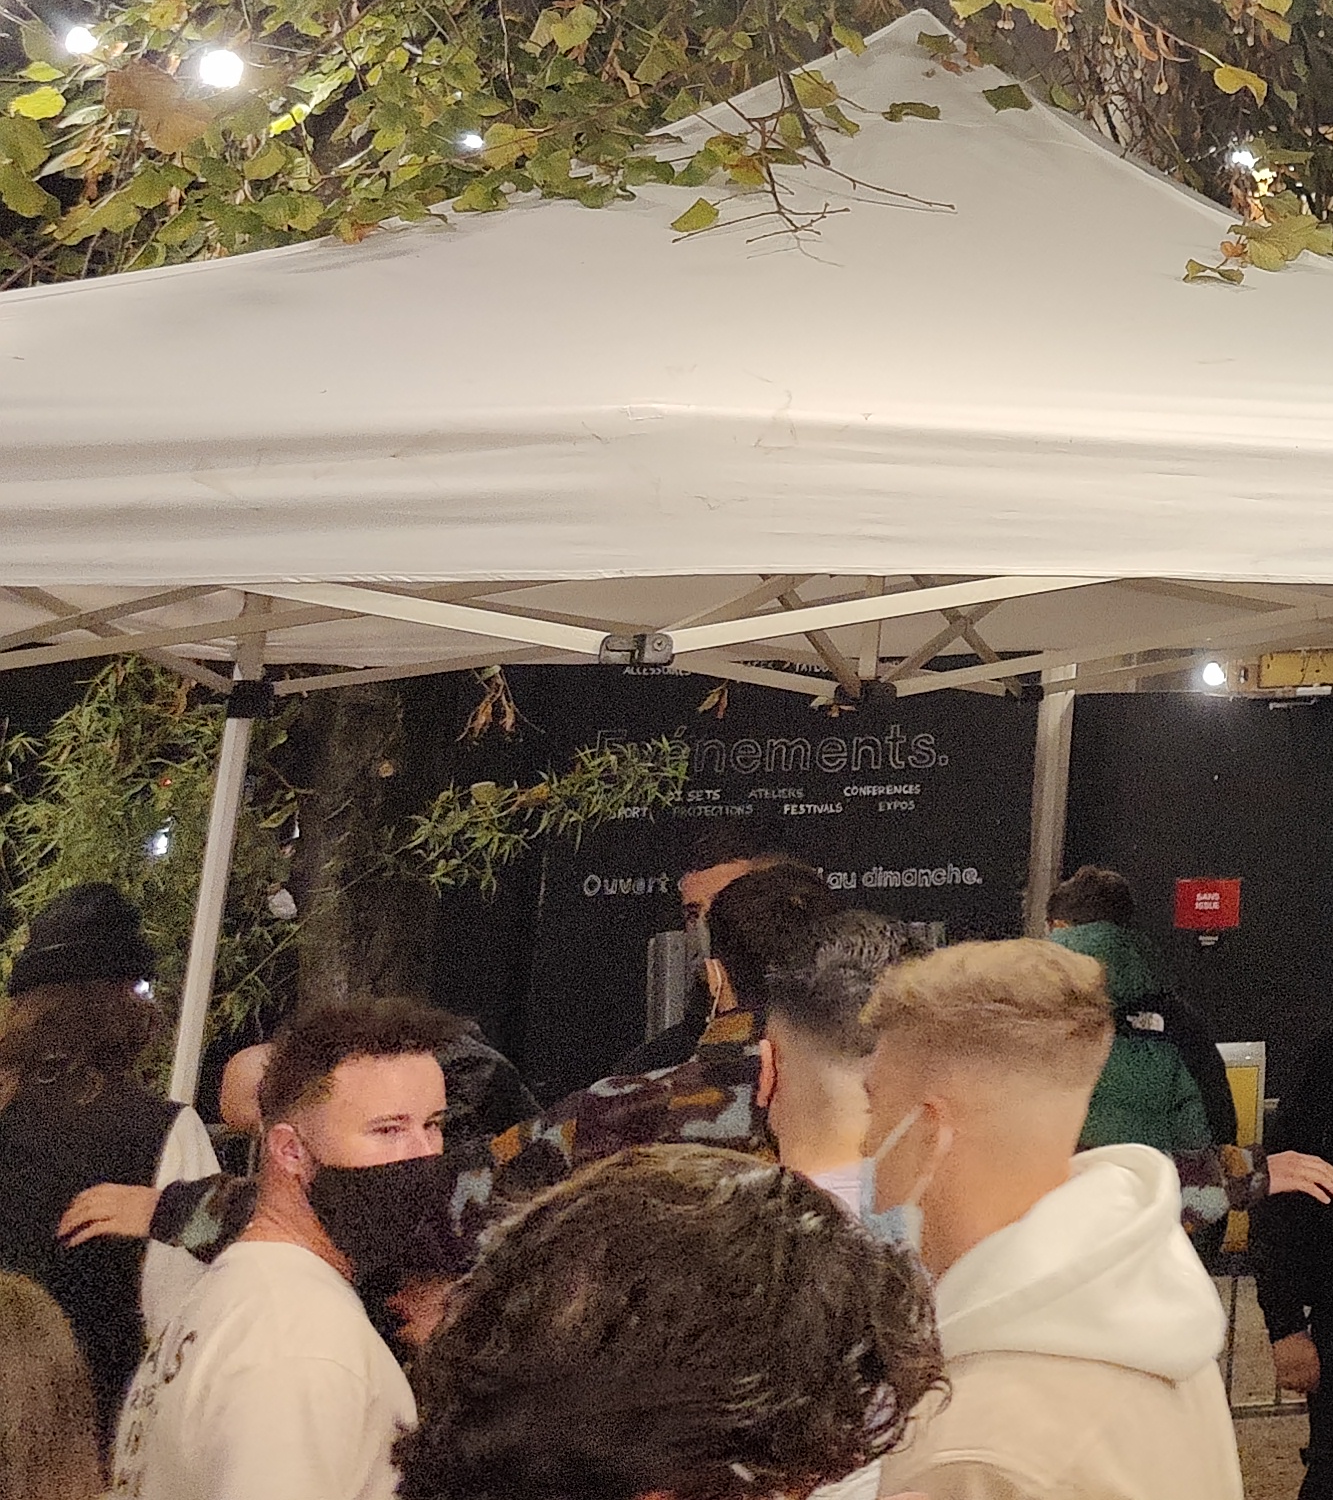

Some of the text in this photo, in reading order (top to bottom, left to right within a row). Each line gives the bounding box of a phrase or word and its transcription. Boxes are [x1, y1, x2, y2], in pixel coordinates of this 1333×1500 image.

[748, 787, 805, 800] ATELIERS
[843, 783, 922, 798] CONFERENCES
[783, 801, 844, 815] FESTIVALS
[878, 799, 916, 813] EXPOS
[583, 871, 671, 897] Ouvert
[826, 871, 857, 890] au
[862, 864, 983, 889] dimanche.
